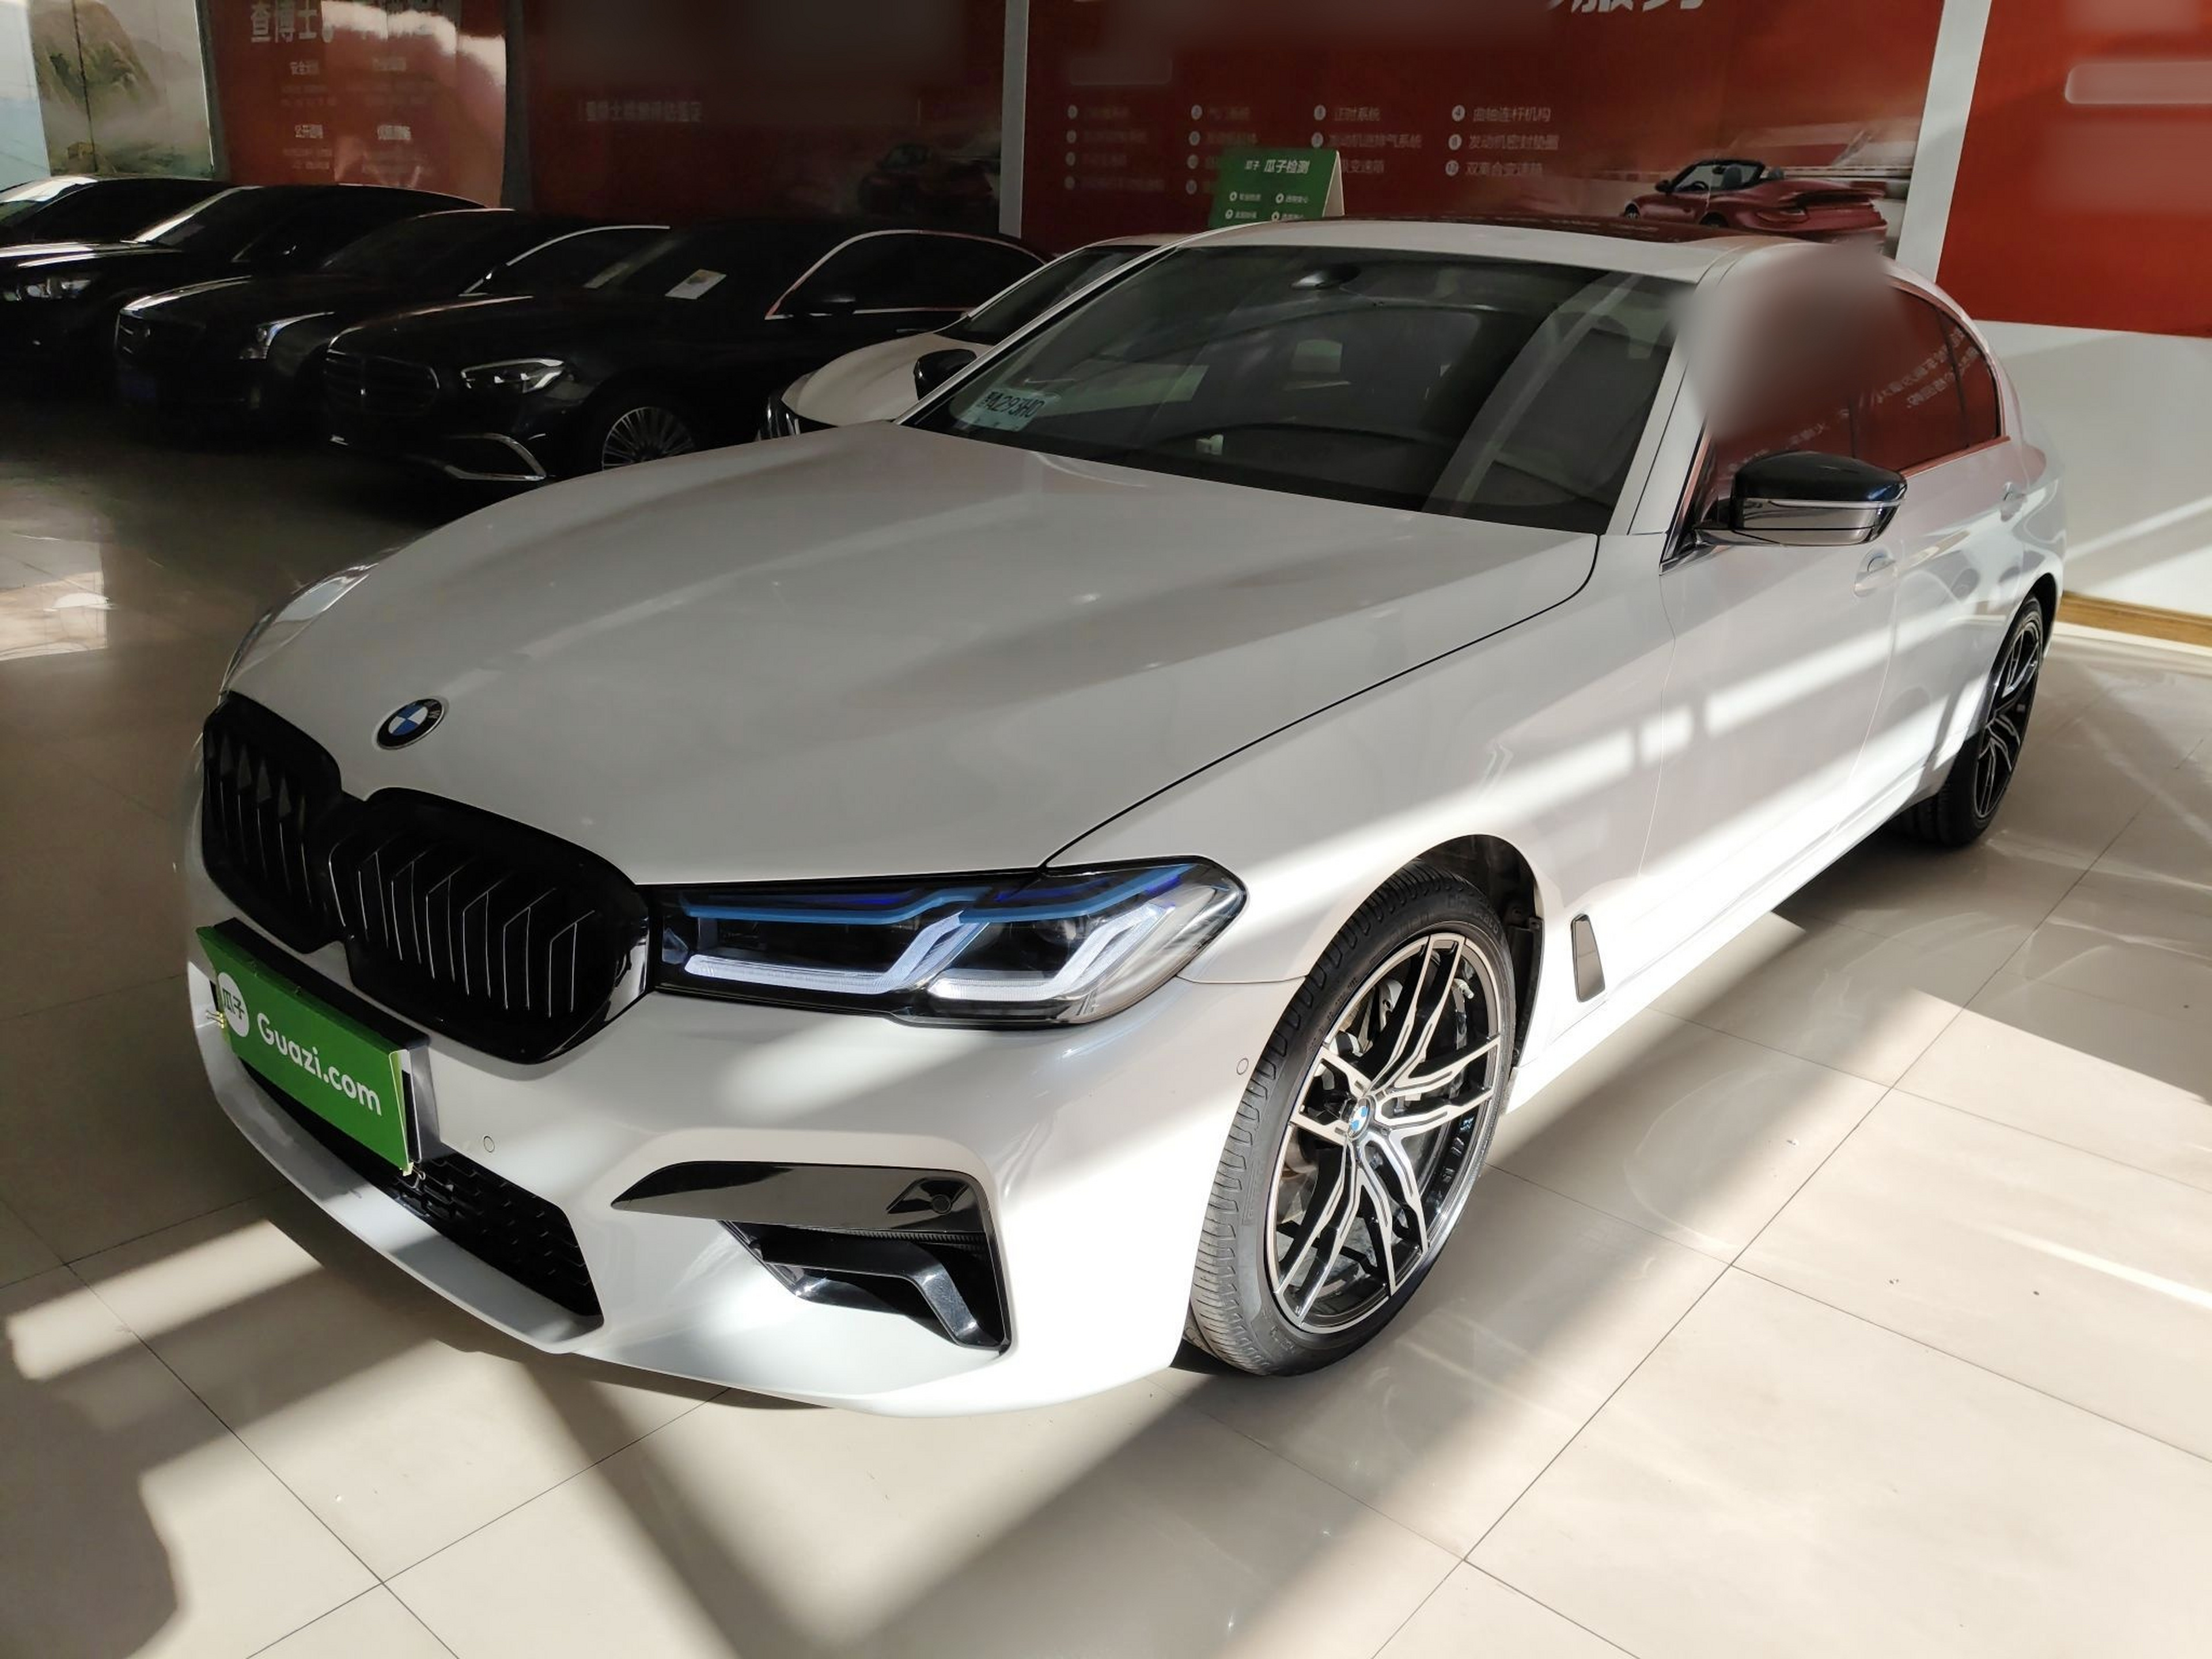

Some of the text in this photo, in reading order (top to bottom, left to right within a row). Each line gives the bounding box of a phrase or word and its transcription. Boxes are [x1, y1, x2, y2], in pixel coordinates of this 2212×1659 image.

[1473, 107, 1551, 122] 曲轴连杆机构
[1264, 159, 1311, 174] 瓜子检测
[257, 1012, 382, 1116] Guazi.com
